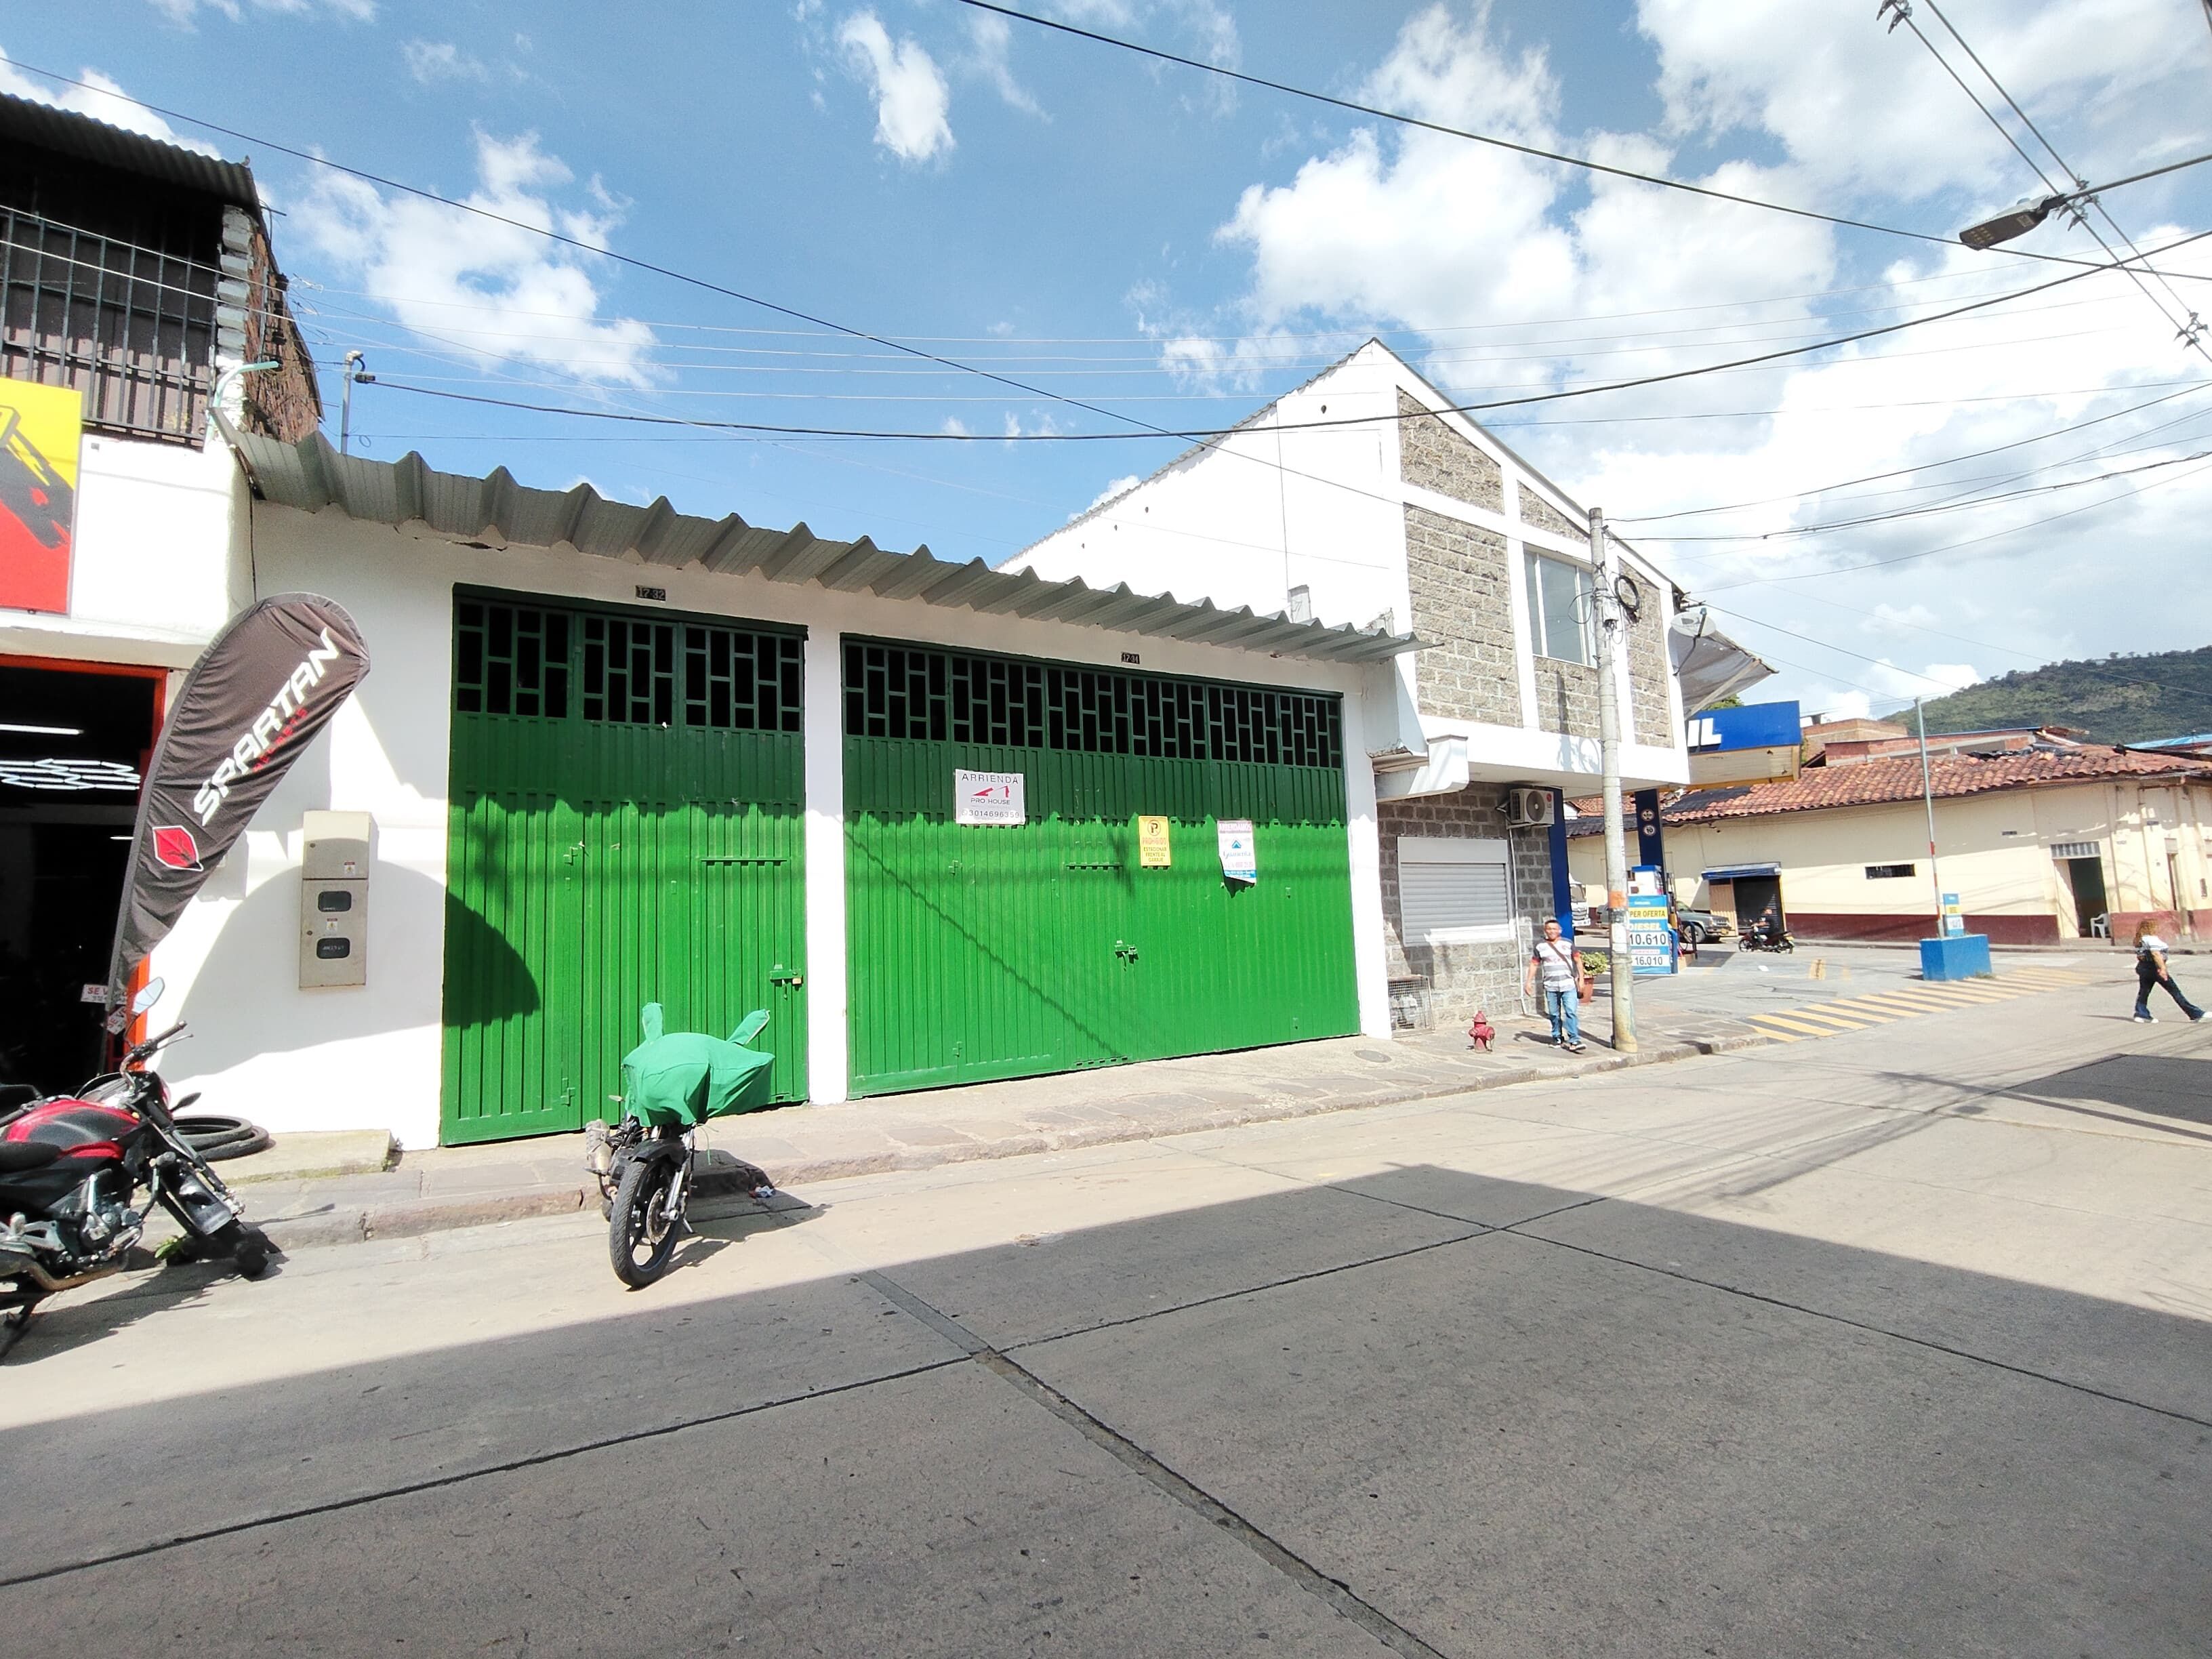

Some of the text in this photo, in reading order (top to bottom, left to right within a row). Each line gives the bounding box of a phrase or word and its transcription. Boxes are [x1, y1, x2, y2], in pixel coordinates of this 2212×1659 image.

[194, 627, 339, 827] SPARTAN
[962, 773, 1019, 784] ARRIENDA
[1628, 922, 1662, 931] DIESEL
[1629, 933, 1666, 945] 10.610
[1635, 956, 1663, 966] 16.010
[87, 987, 100, 995] SE
